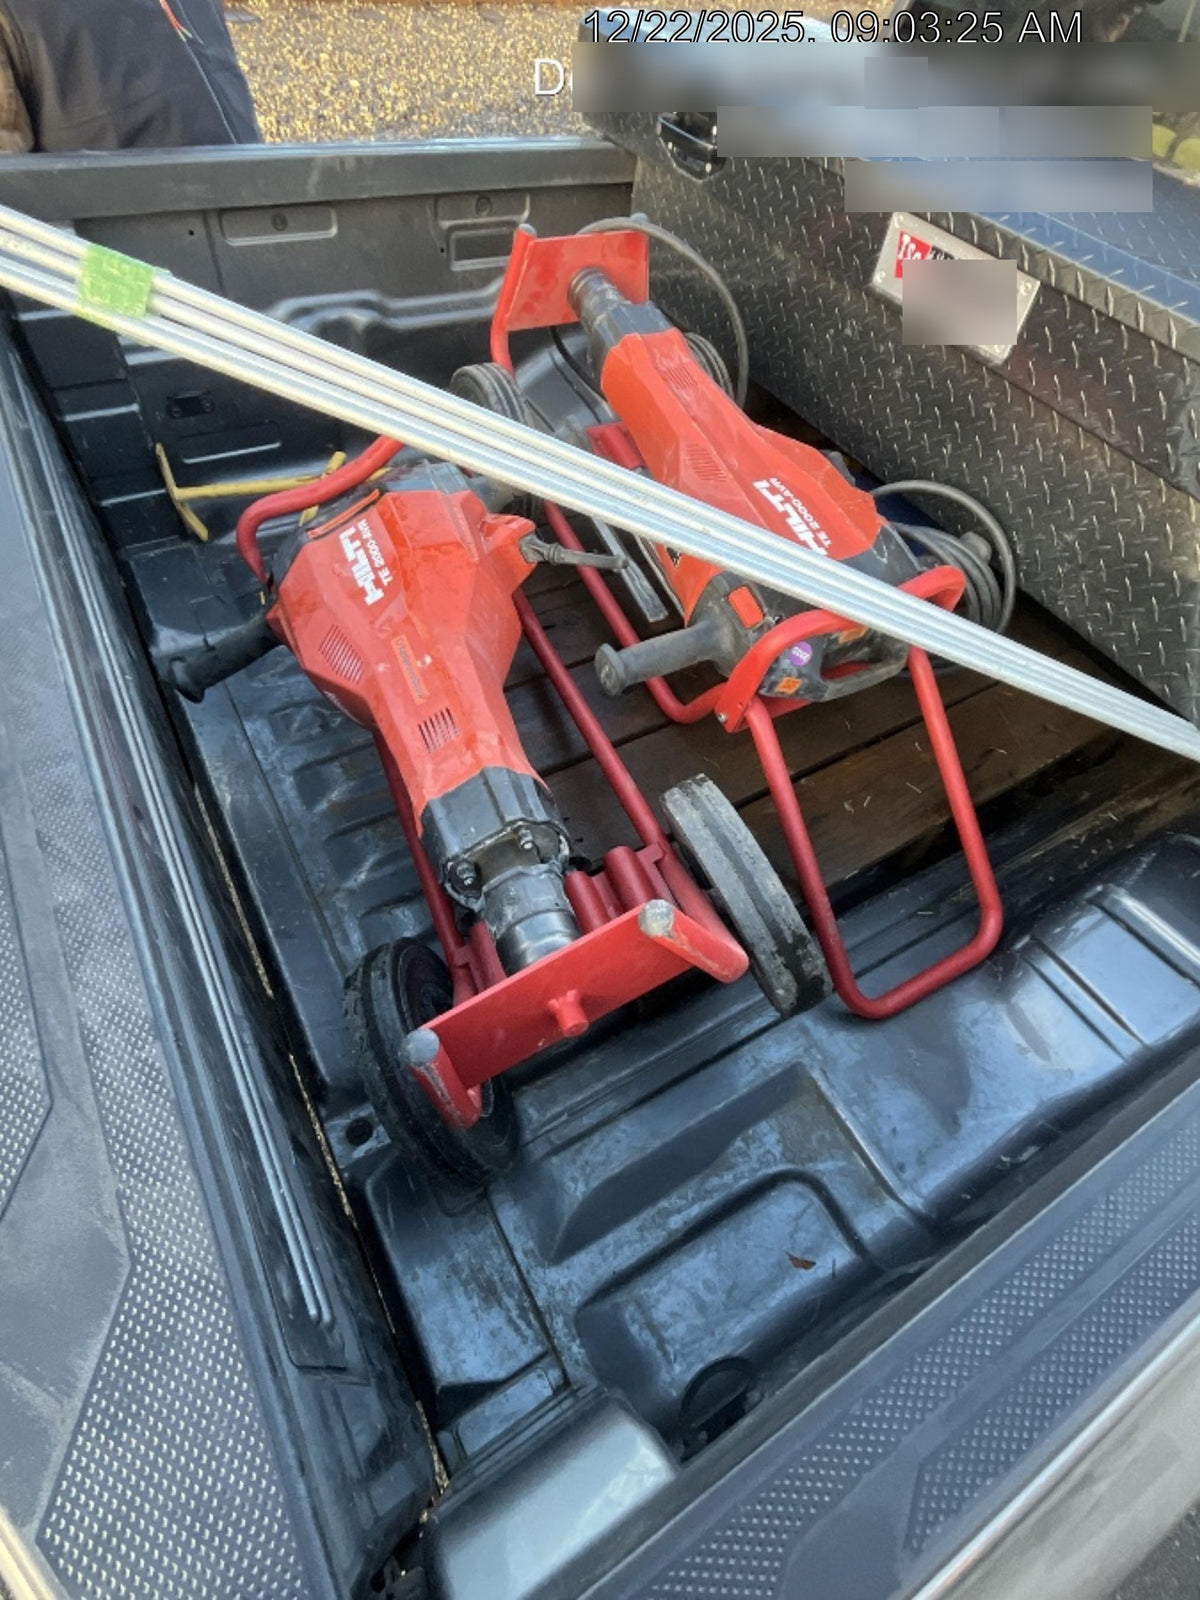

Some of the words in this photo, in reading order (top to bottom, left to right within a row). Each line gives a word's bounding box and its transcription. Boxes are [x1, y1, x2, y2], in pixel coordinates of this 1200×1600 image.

[752, 479, 829, 557] HILTI
[768, 476, 821, 530] 2000-AVR
[338, 525, 385, 606] HILTI
[815, 530, 833, 548] TE
[377, 566, 394, 587] TE
